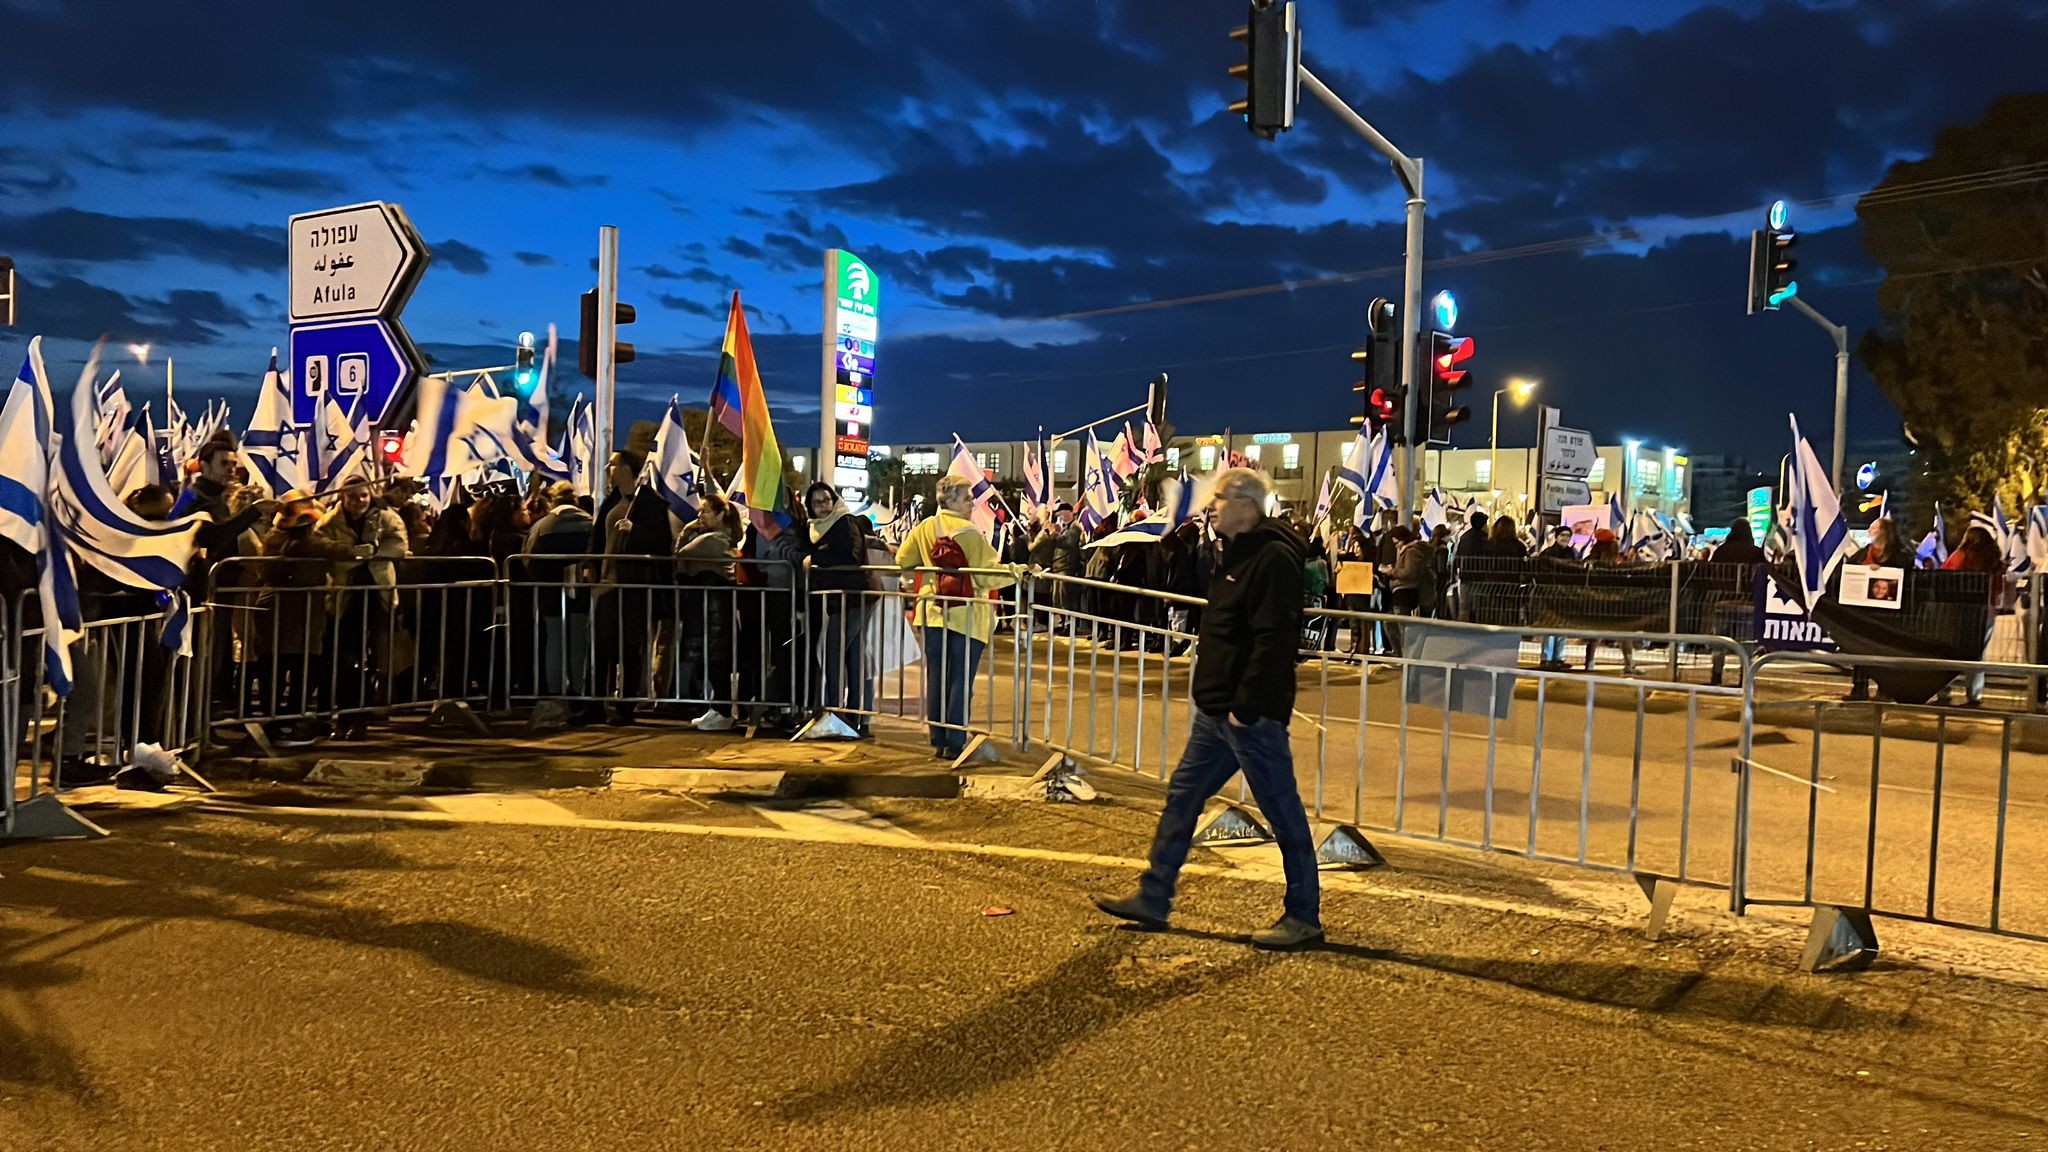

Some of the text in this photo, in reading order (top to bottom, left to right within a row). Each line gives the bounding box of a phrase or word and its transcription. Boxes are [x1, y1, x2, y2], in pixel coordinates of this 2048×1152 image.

[311, 225, 358, 248] עפולה
[313, 283, 356, 304] Afula
[349, 365, 356, 382] 6
